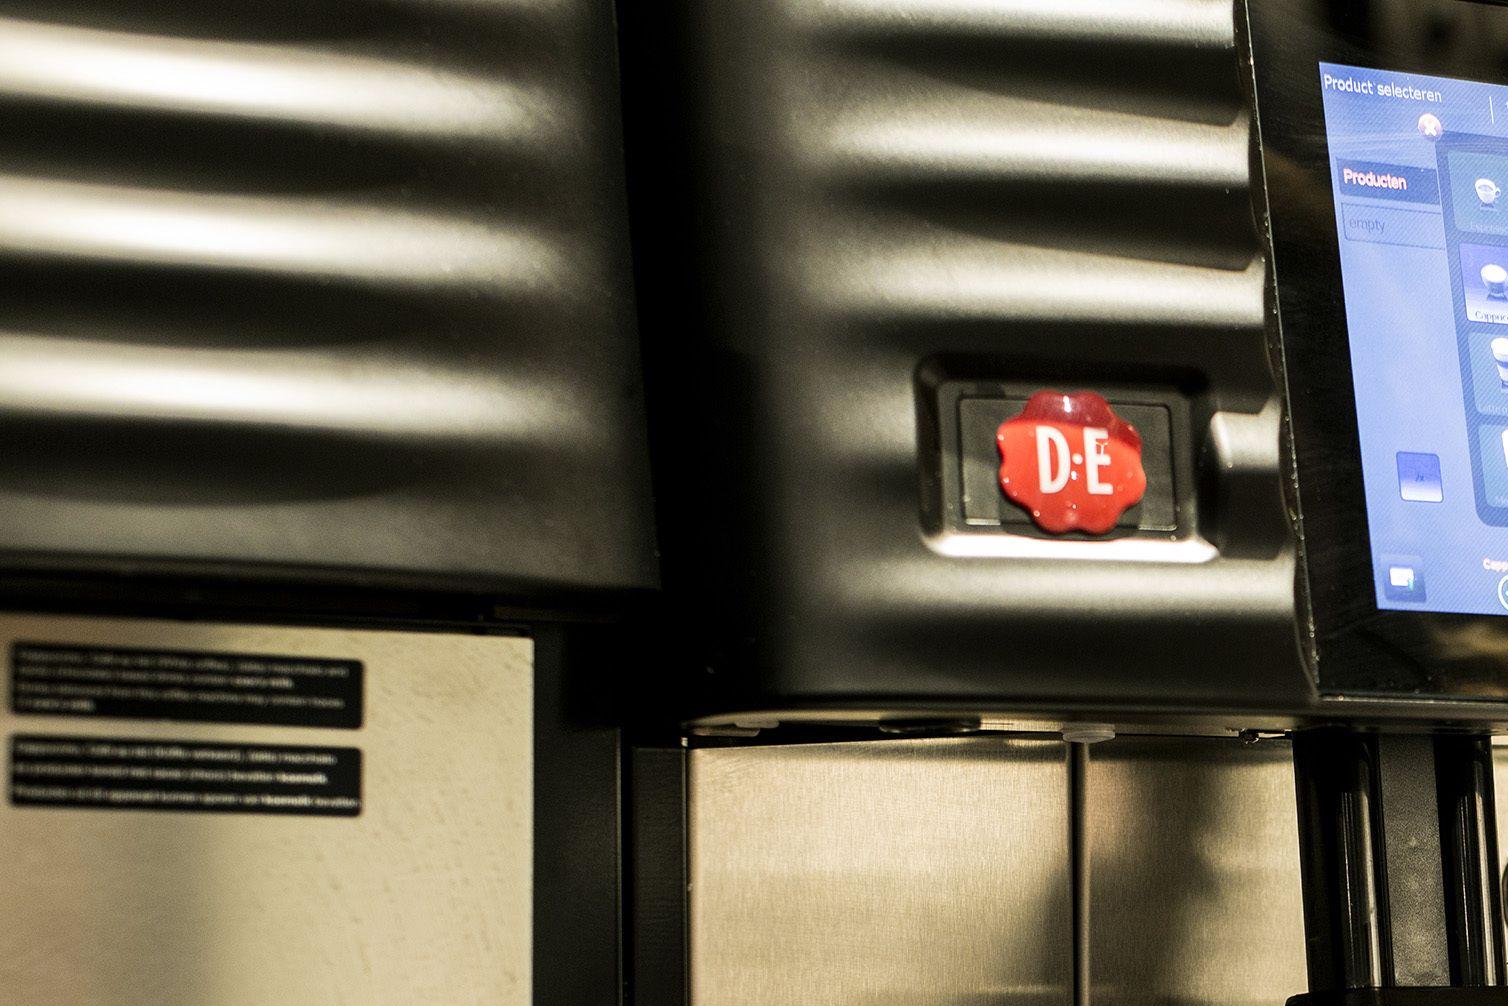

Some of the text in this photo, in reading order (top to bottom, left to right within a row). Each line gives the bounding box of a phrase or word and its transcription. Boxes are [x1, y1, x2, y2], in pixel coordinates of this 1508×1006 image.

[1323, 74, 1442, 102] Product selecteren
[1343, 167, 1407, 190] Producten
[1349, 219, 1385, 234] empty
